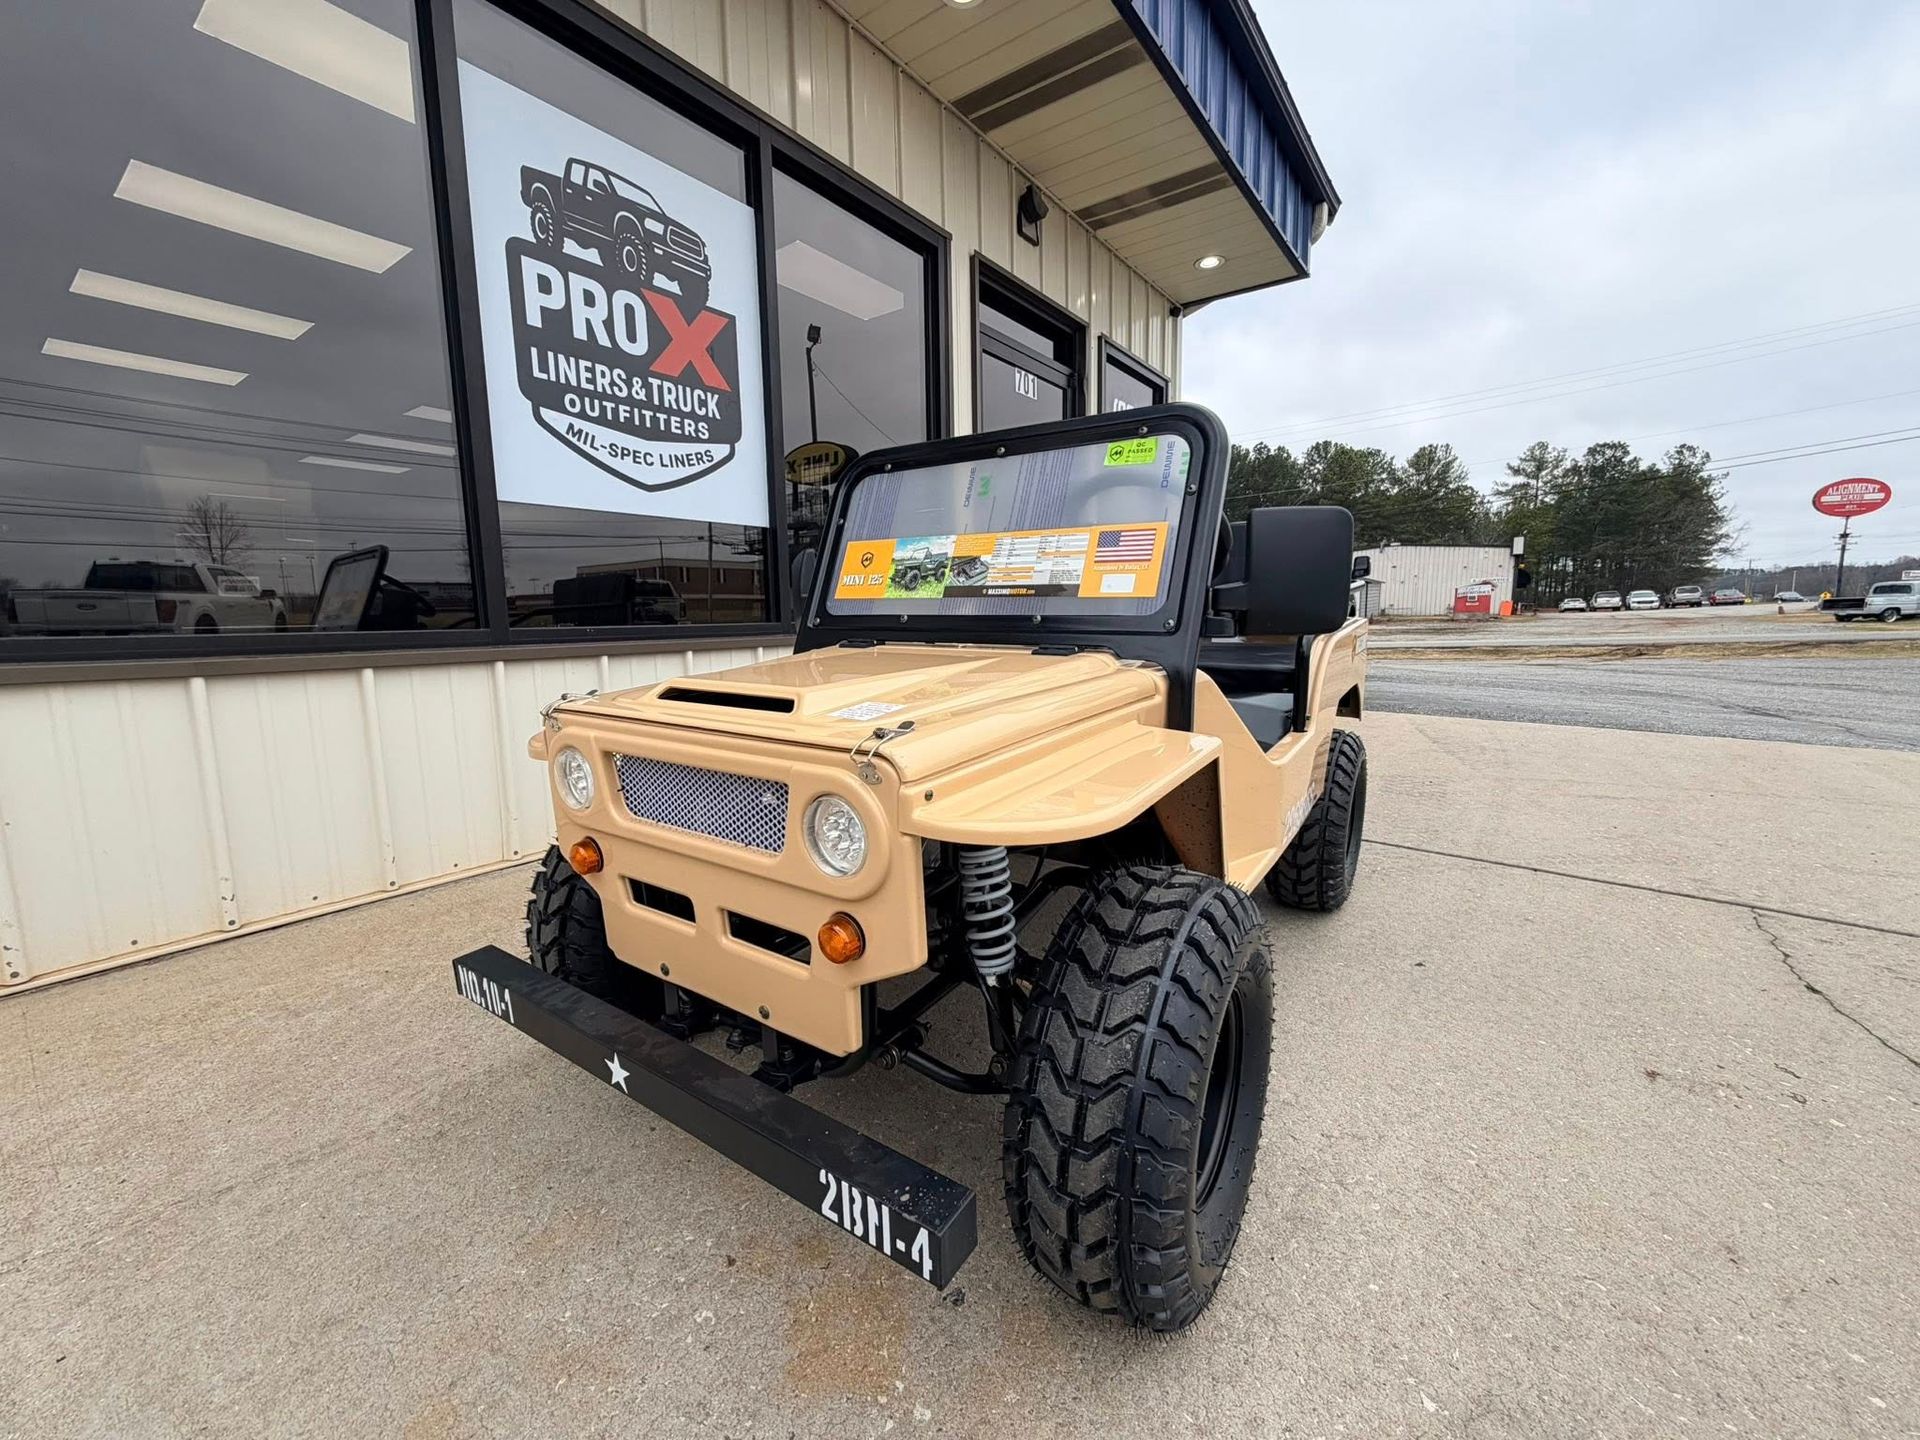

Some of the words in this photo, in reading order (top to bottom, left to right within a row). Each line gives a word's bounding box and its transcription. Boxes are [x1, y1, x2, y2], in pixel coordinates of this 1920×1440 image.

[530, 346, 628, 398] LINERS
[648, 376, 722, 420] TRUCK
[1015, 369, 1038, 399] 701
[563, 393, 710, 440] OUTFITTERS
[565, 422, 655, 468] MIL-SPEC
[659, 449, 716, 469] LINERS
[1127, 447, 1153, 455] PASSED
[1826, 483, 1881, 496] ALIGNMENT
[841, 574, 865, 587] MINI
[868, 574, 884, 586] 125
[819, 1168, 933, 1281] 2BN-4
